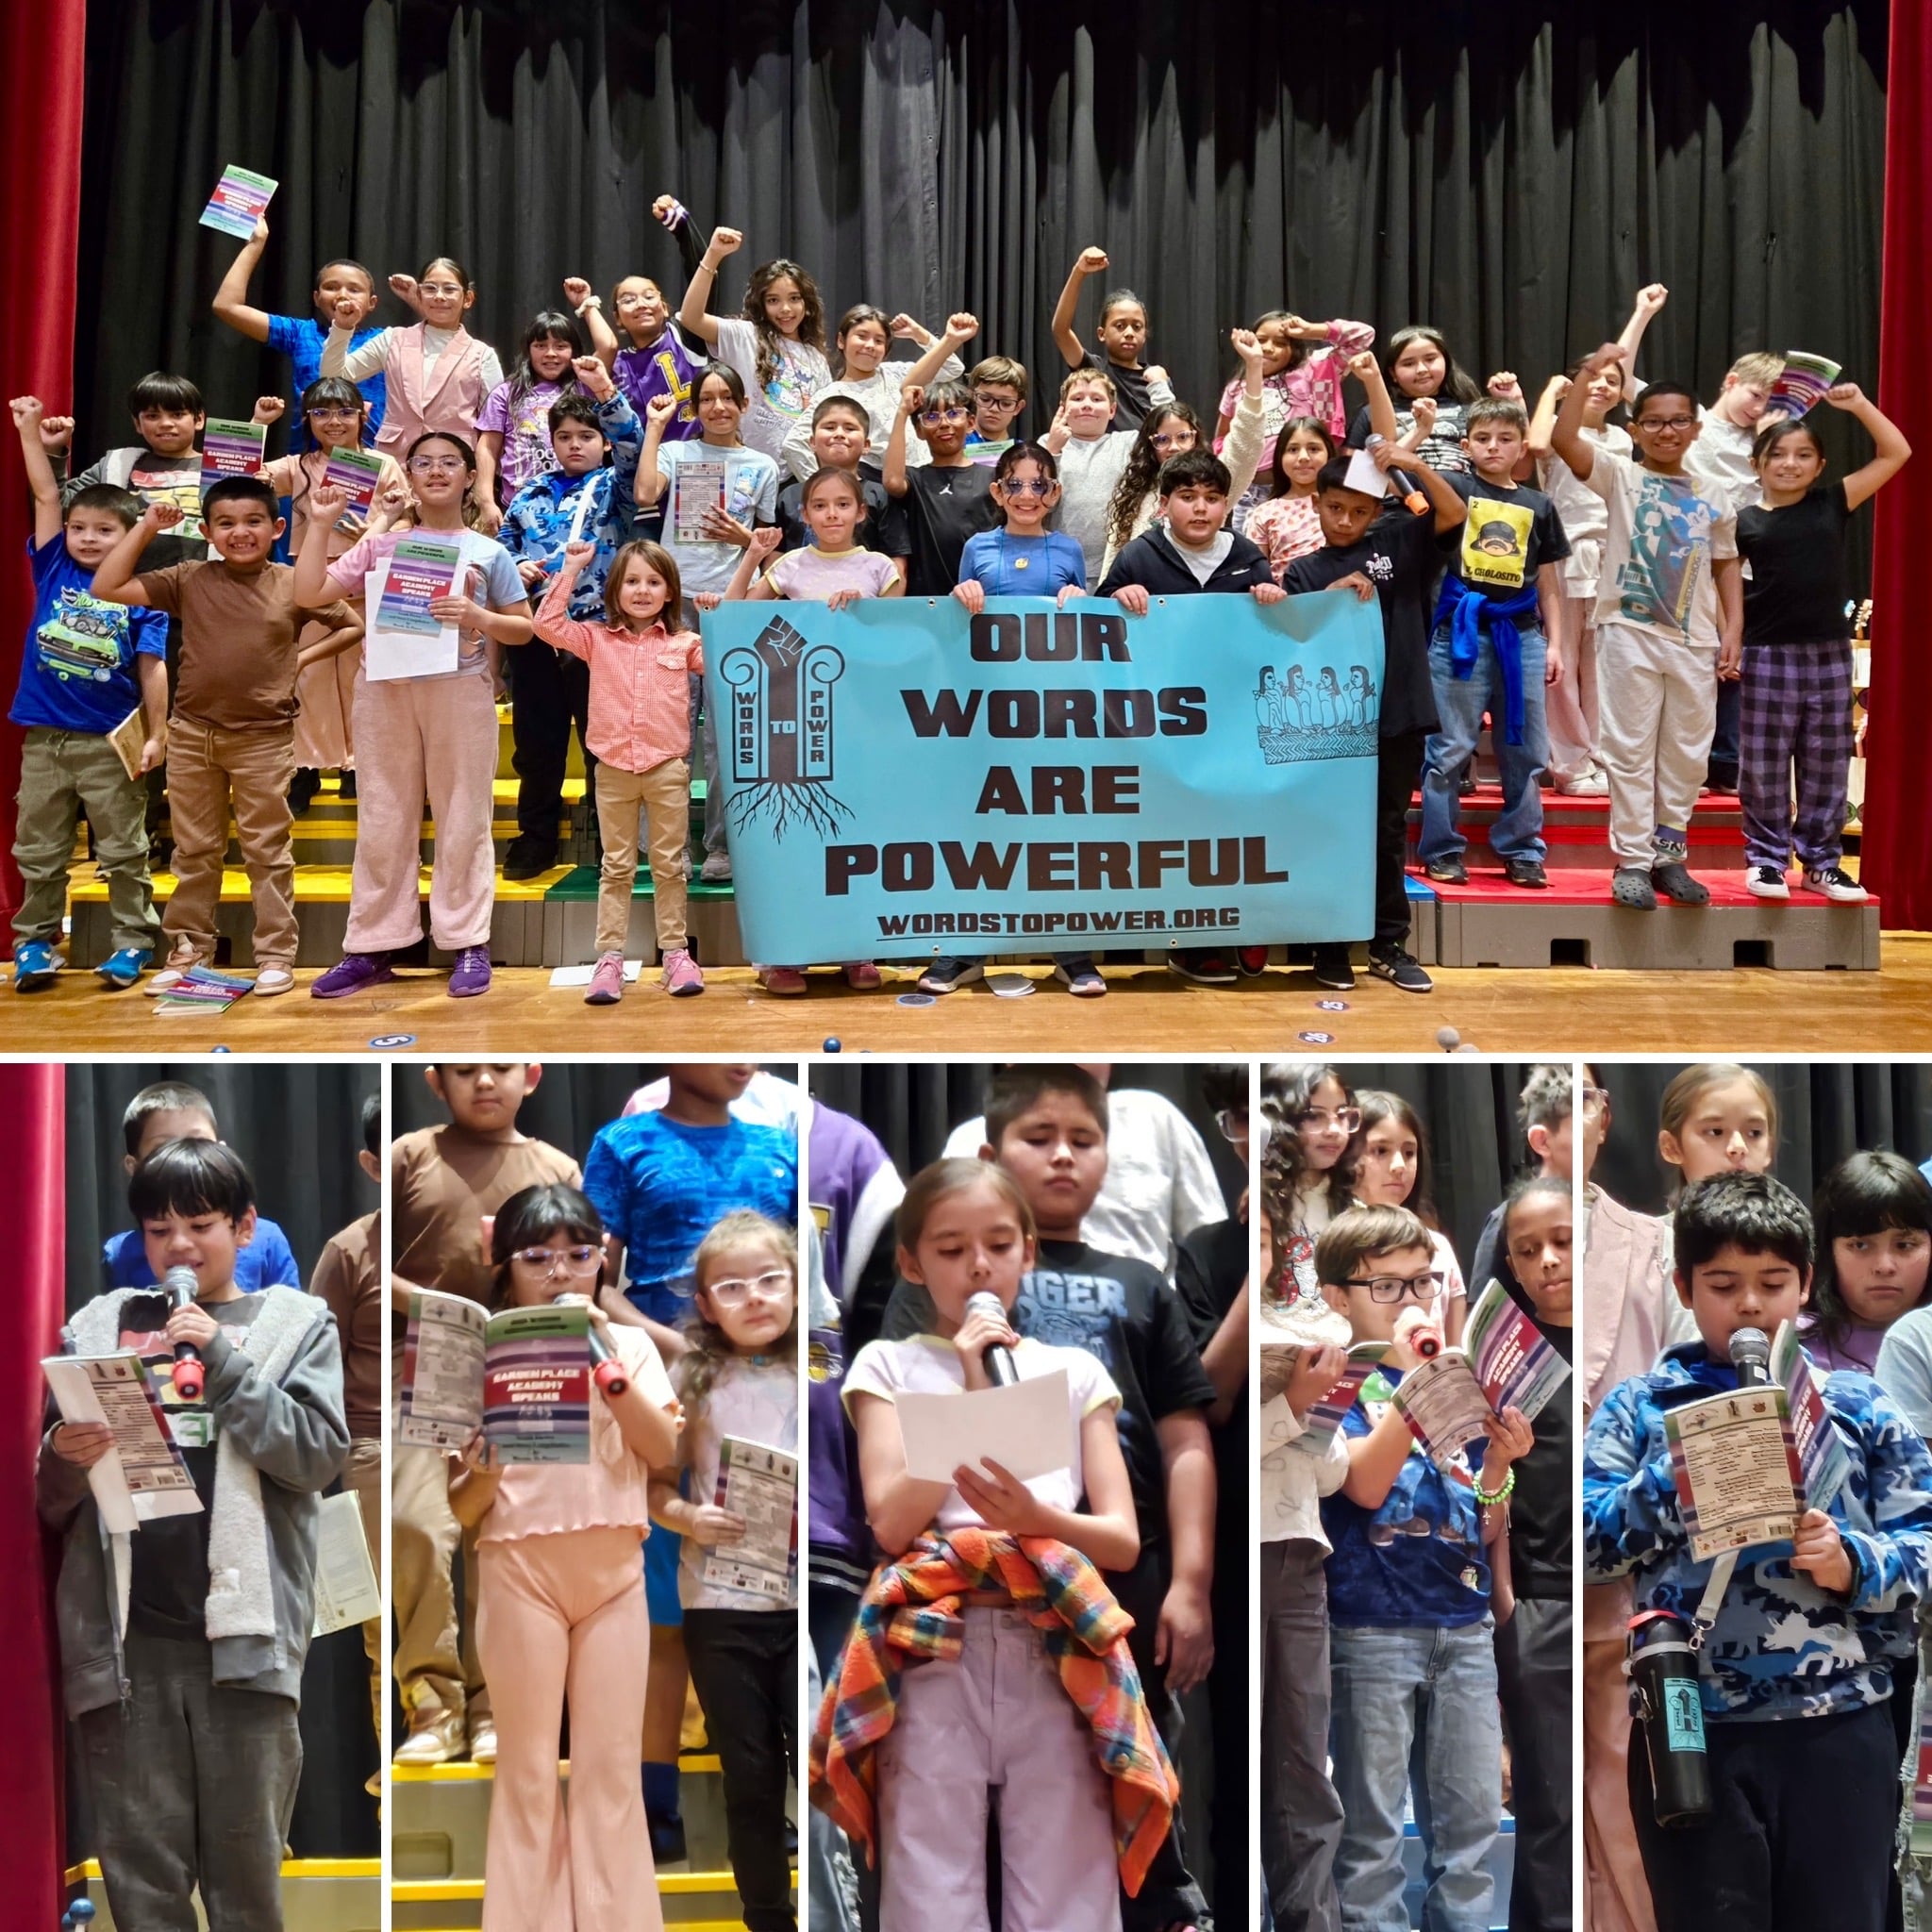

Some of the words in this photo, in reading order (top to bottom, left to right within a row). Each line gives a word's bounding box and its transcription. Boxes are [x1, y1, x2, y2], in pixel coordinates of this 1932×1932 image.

[235, 454, 258, 462] PLACE
[392, 574, 422, 583] GARDEN
[422, 577, 447, 587] PLACE
[400, 581, 436, 591] ACADEMY
[1474, 567, 1521, 582] CHOLOSITO
[970, 613, 1130, 661] OUR
[736, 691, 757, 764] WORDS
[770, 720, 796, 734] TO
[807, 691, 828, 762] POWER
[900, 687, 1208, 738] WORDS
[975, 765, 1140, 814] ARE
[825, 836, 1288, 895] POWERFUL
[877, 908, 1240, 935] WORDSTOPOWER.ORG
[1023, 1271, 1128, 1318] IGER
[1502, 1322, 1524, 1352] PLACE
[1493, 1339, 1521, 1382] ACADEMY
[1498, 1349, 1524, 1386] SPEAKS
[492, 1369, 541, 1384] GARDEN
[541, 1368, 580, 1379] PLACE
[507, 1380, 564, 1391] ACADEMY
[511, 1391, 560, 1403] SPEAKS
